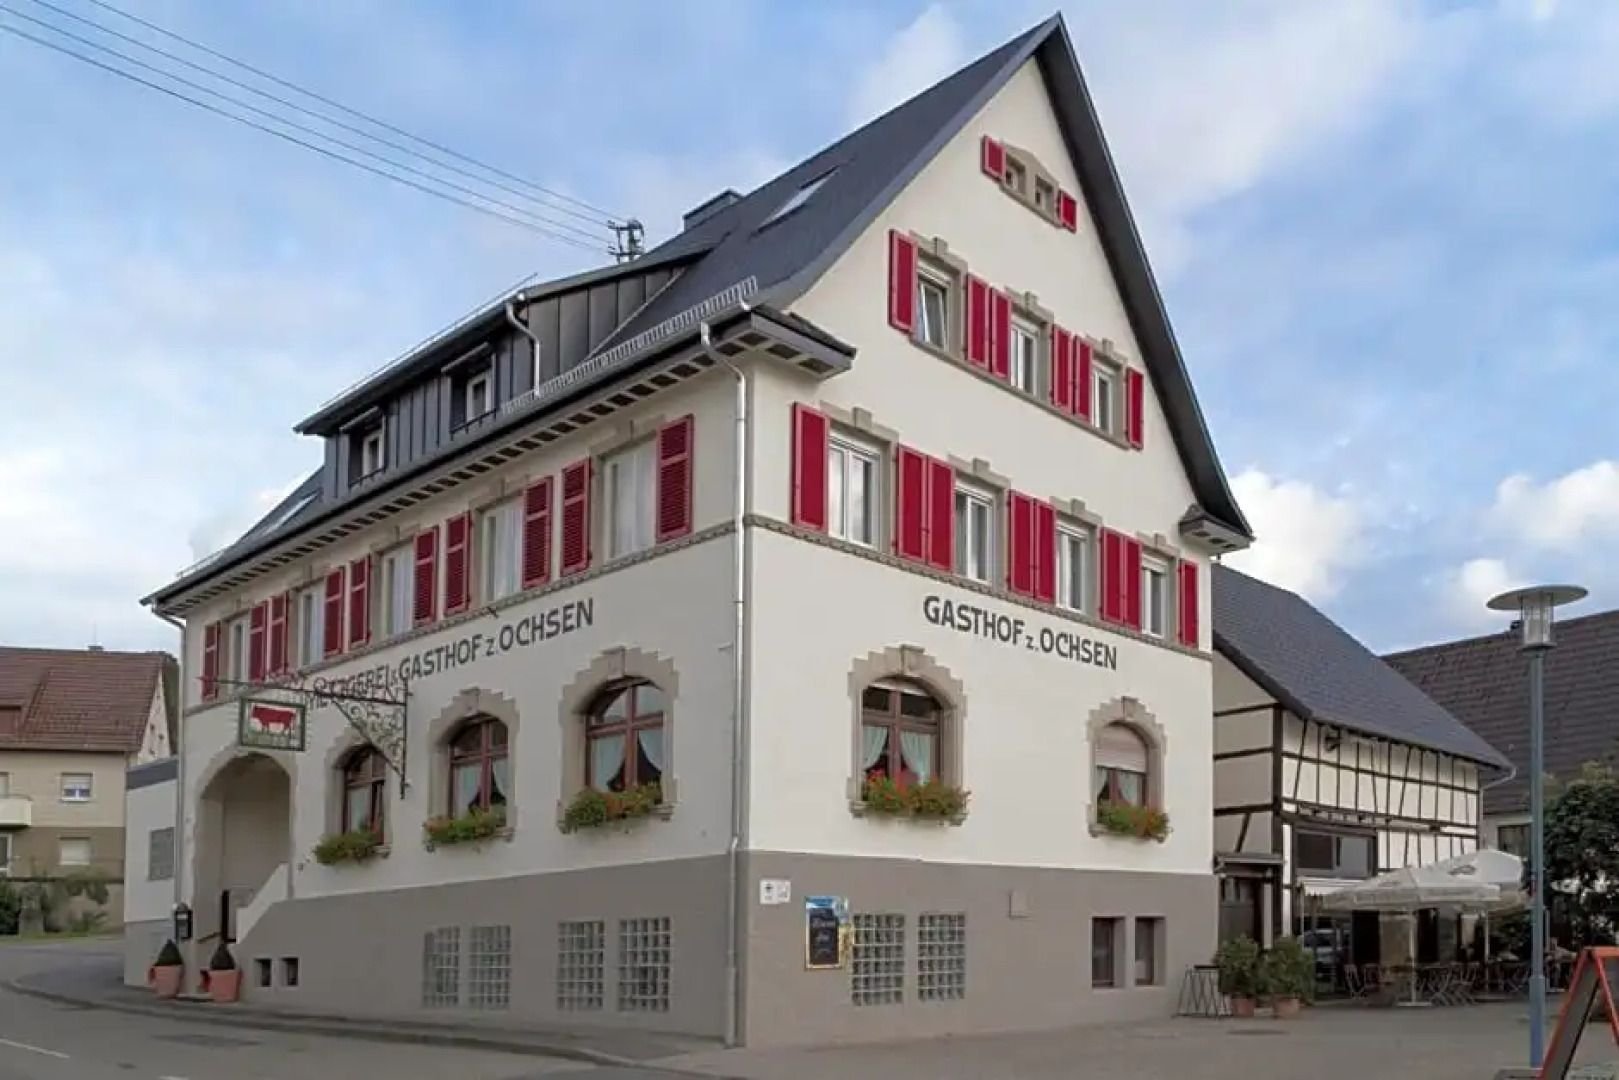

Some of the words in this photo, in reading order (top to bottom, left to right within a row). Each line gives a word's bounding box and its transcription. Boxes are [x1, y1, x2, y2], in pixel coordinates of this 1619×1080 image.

[399, 633, 483, 681] GASTHOF
[500, 598, 594, 651] OCHSEN
[923, 595, 1025, 645] GASTHOF
[1040, 627, 1117, 670] OCHSEN
